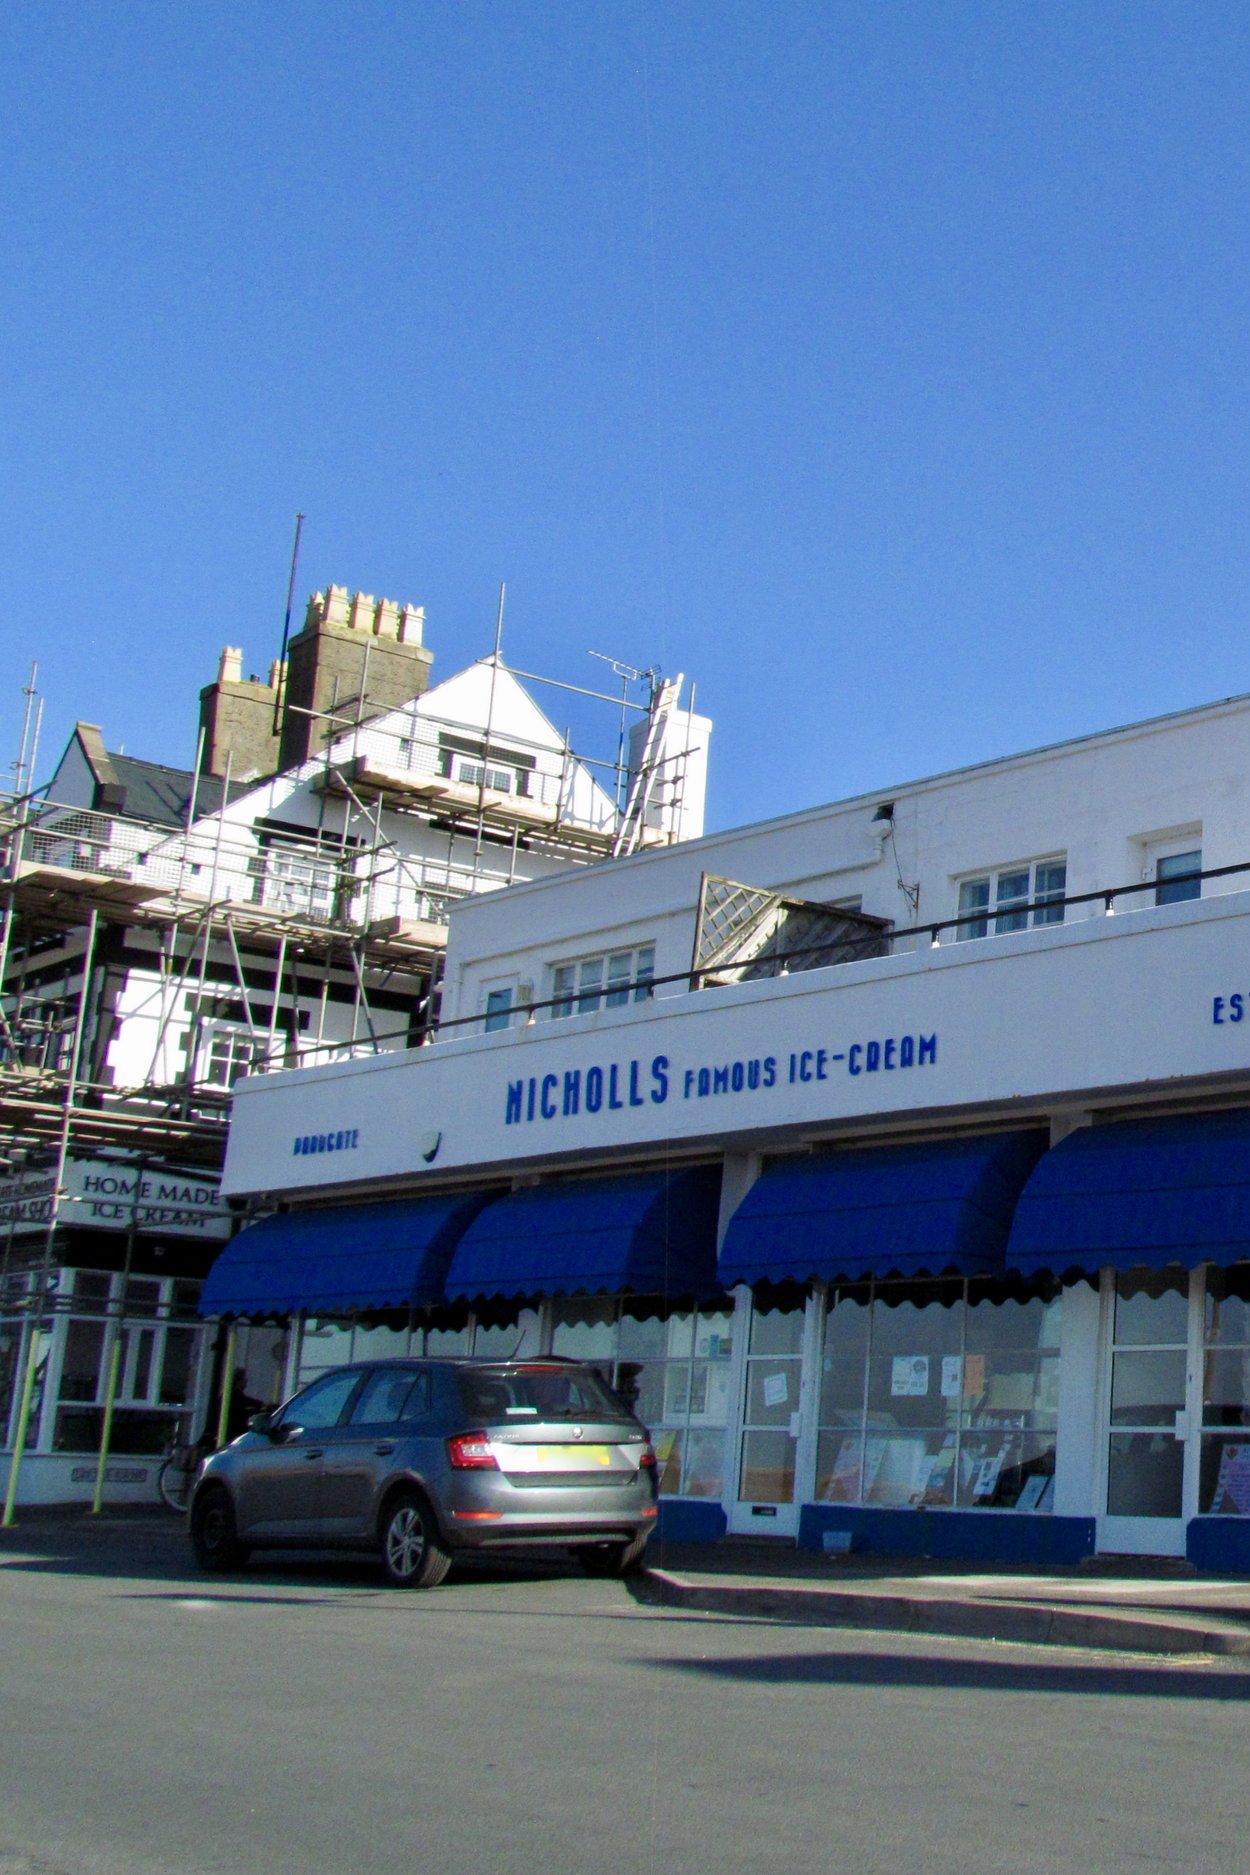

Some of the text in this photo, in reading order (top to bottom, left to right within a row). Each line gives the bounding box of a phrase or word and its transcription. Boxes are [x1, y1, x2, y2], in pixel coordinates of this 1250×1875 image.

[505, 1033, 938, 1125] NICHOLLS FAMOUS ICE-CREAM
[83, 1175, 152, 1198] HOME
[157, 1184, 221, 1206] MADE
[91, 1202, 206, 1228] ICE CREAM
